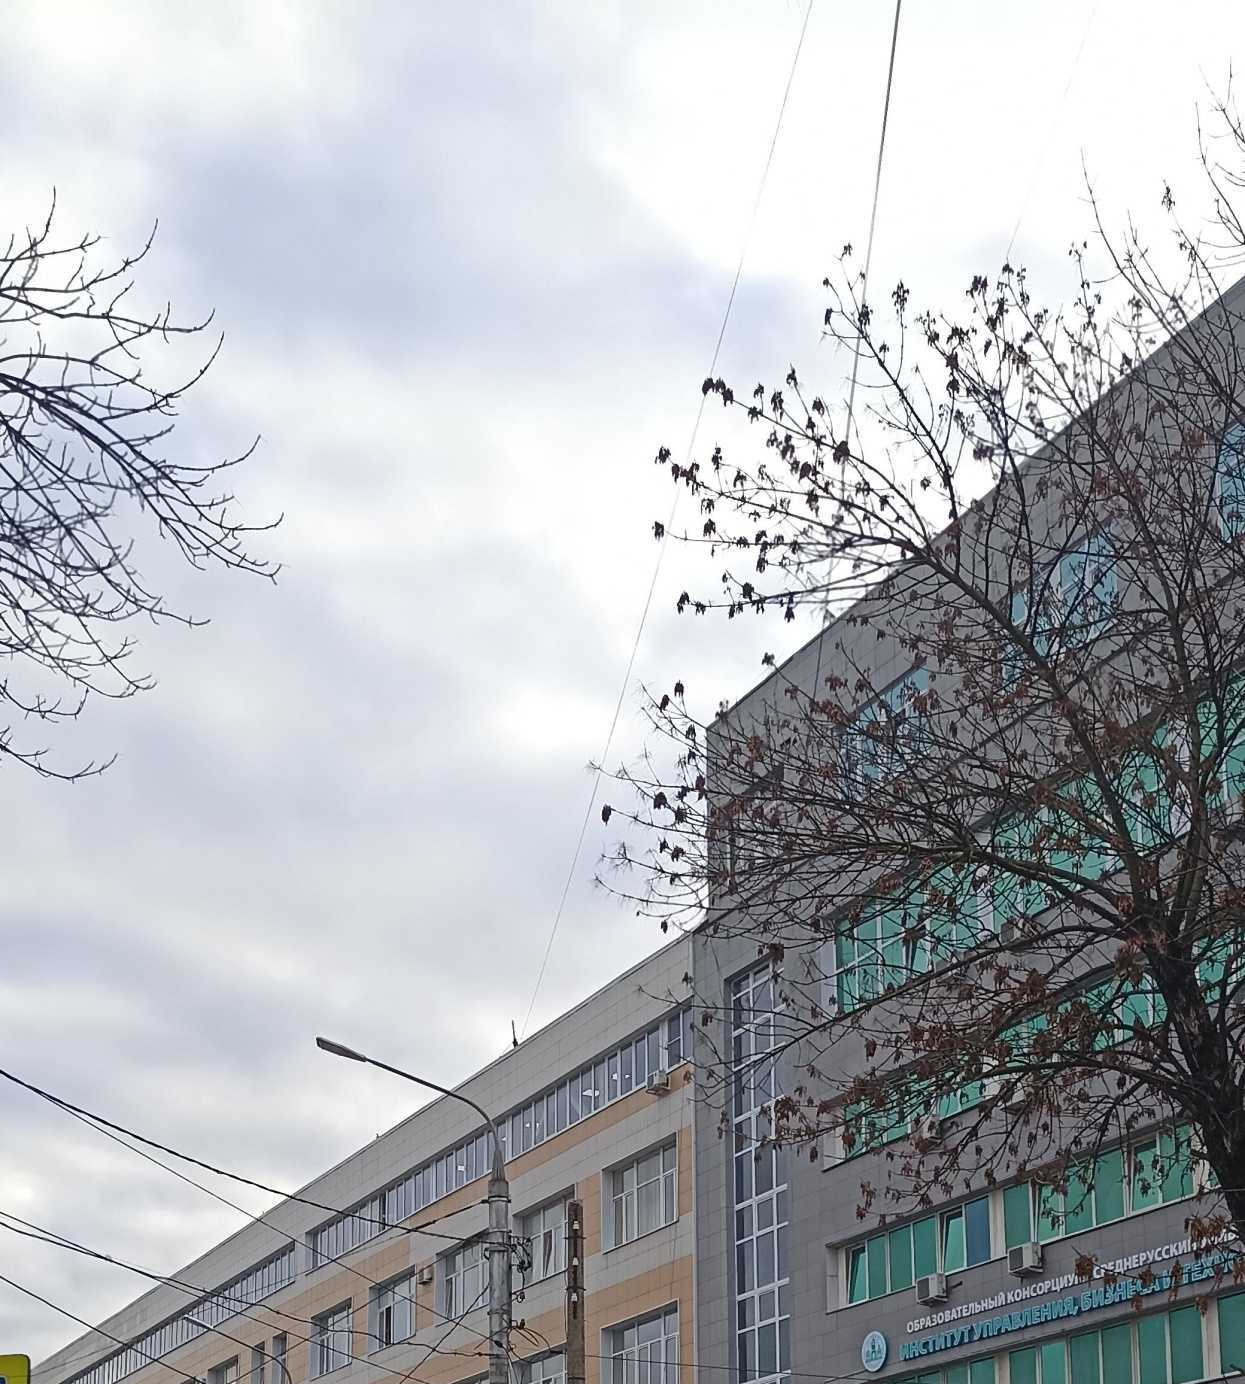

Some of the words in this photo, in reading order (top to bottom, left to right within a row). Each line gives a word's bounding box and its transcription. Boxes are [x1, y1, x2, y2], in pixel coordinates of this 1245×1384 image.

[900, 1326, 971, 1361] ИНСТИТУТ
[972, 1296, 1080, 1341] УПРАВЛЕНИЯ,
[906, 1290, 1006, 1334] ОБРАЗОВАТЕЛЬНЫЙ
